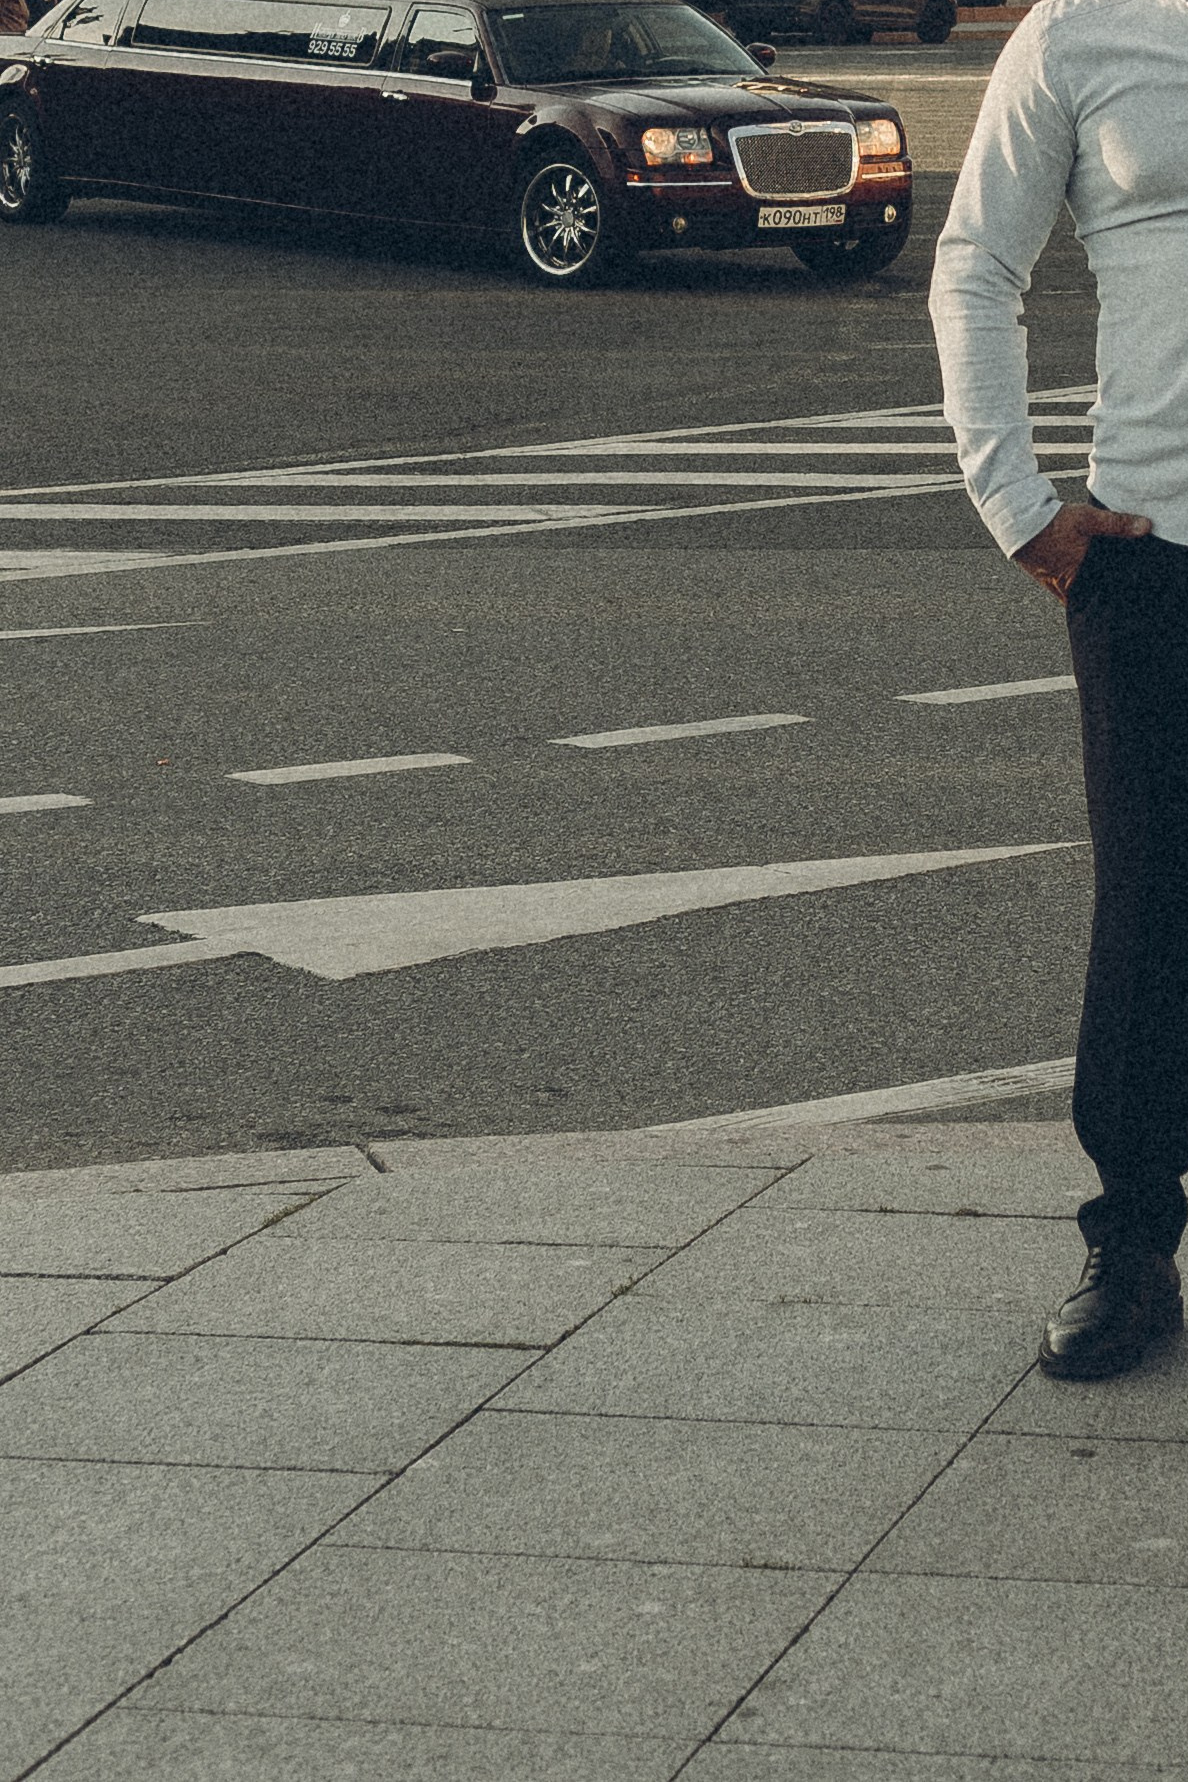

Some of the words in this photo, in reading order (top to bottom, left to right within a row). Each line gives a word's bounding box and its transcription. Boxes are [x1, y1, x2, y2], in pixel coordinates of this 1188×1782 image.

[307, 40, 329, 55] 929
[328, 43, 343, 56] 55
[342, 44, 358, 58] 55
